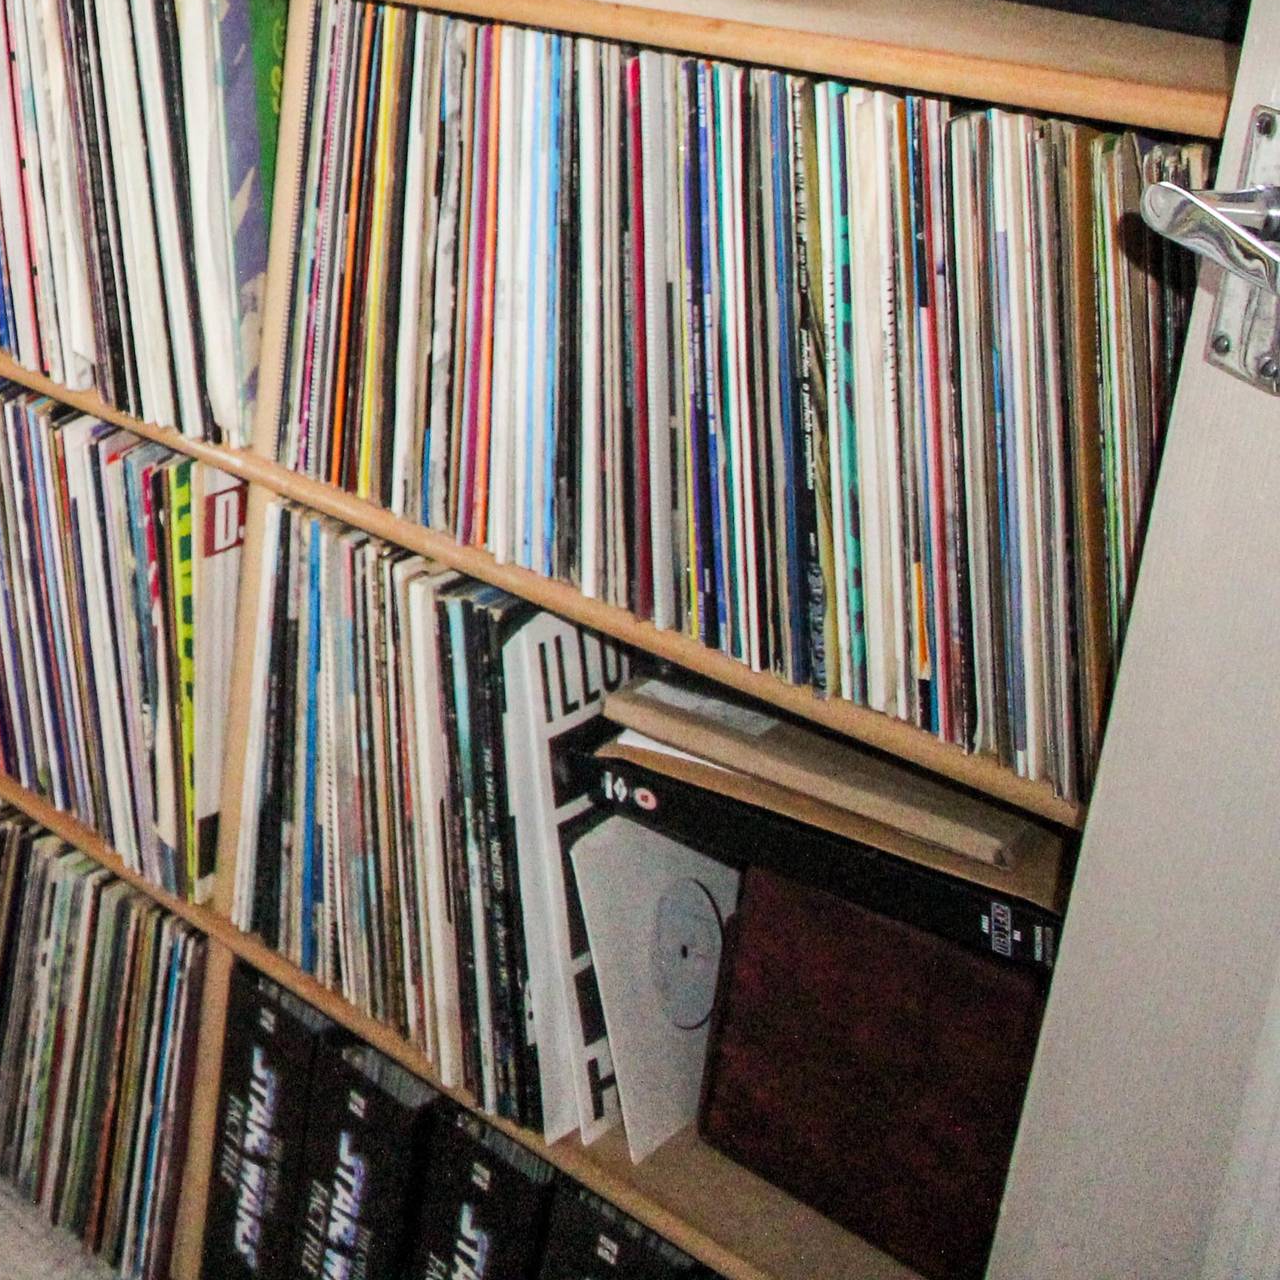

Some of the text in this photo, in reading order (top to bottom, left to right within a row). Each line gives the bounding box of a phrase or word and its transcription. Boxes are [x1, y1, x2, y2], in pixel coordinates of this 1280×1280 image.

[538, 624, 632, 724] ILLU
[243, 1045, 276, 1155] STAR
[234, 1156, 266, 1269] WARS
[308, 1179, 330, 1233] FACT
[327, 1130, 366, 1248] STAR
[450, 1202, 489, 1280] STA
